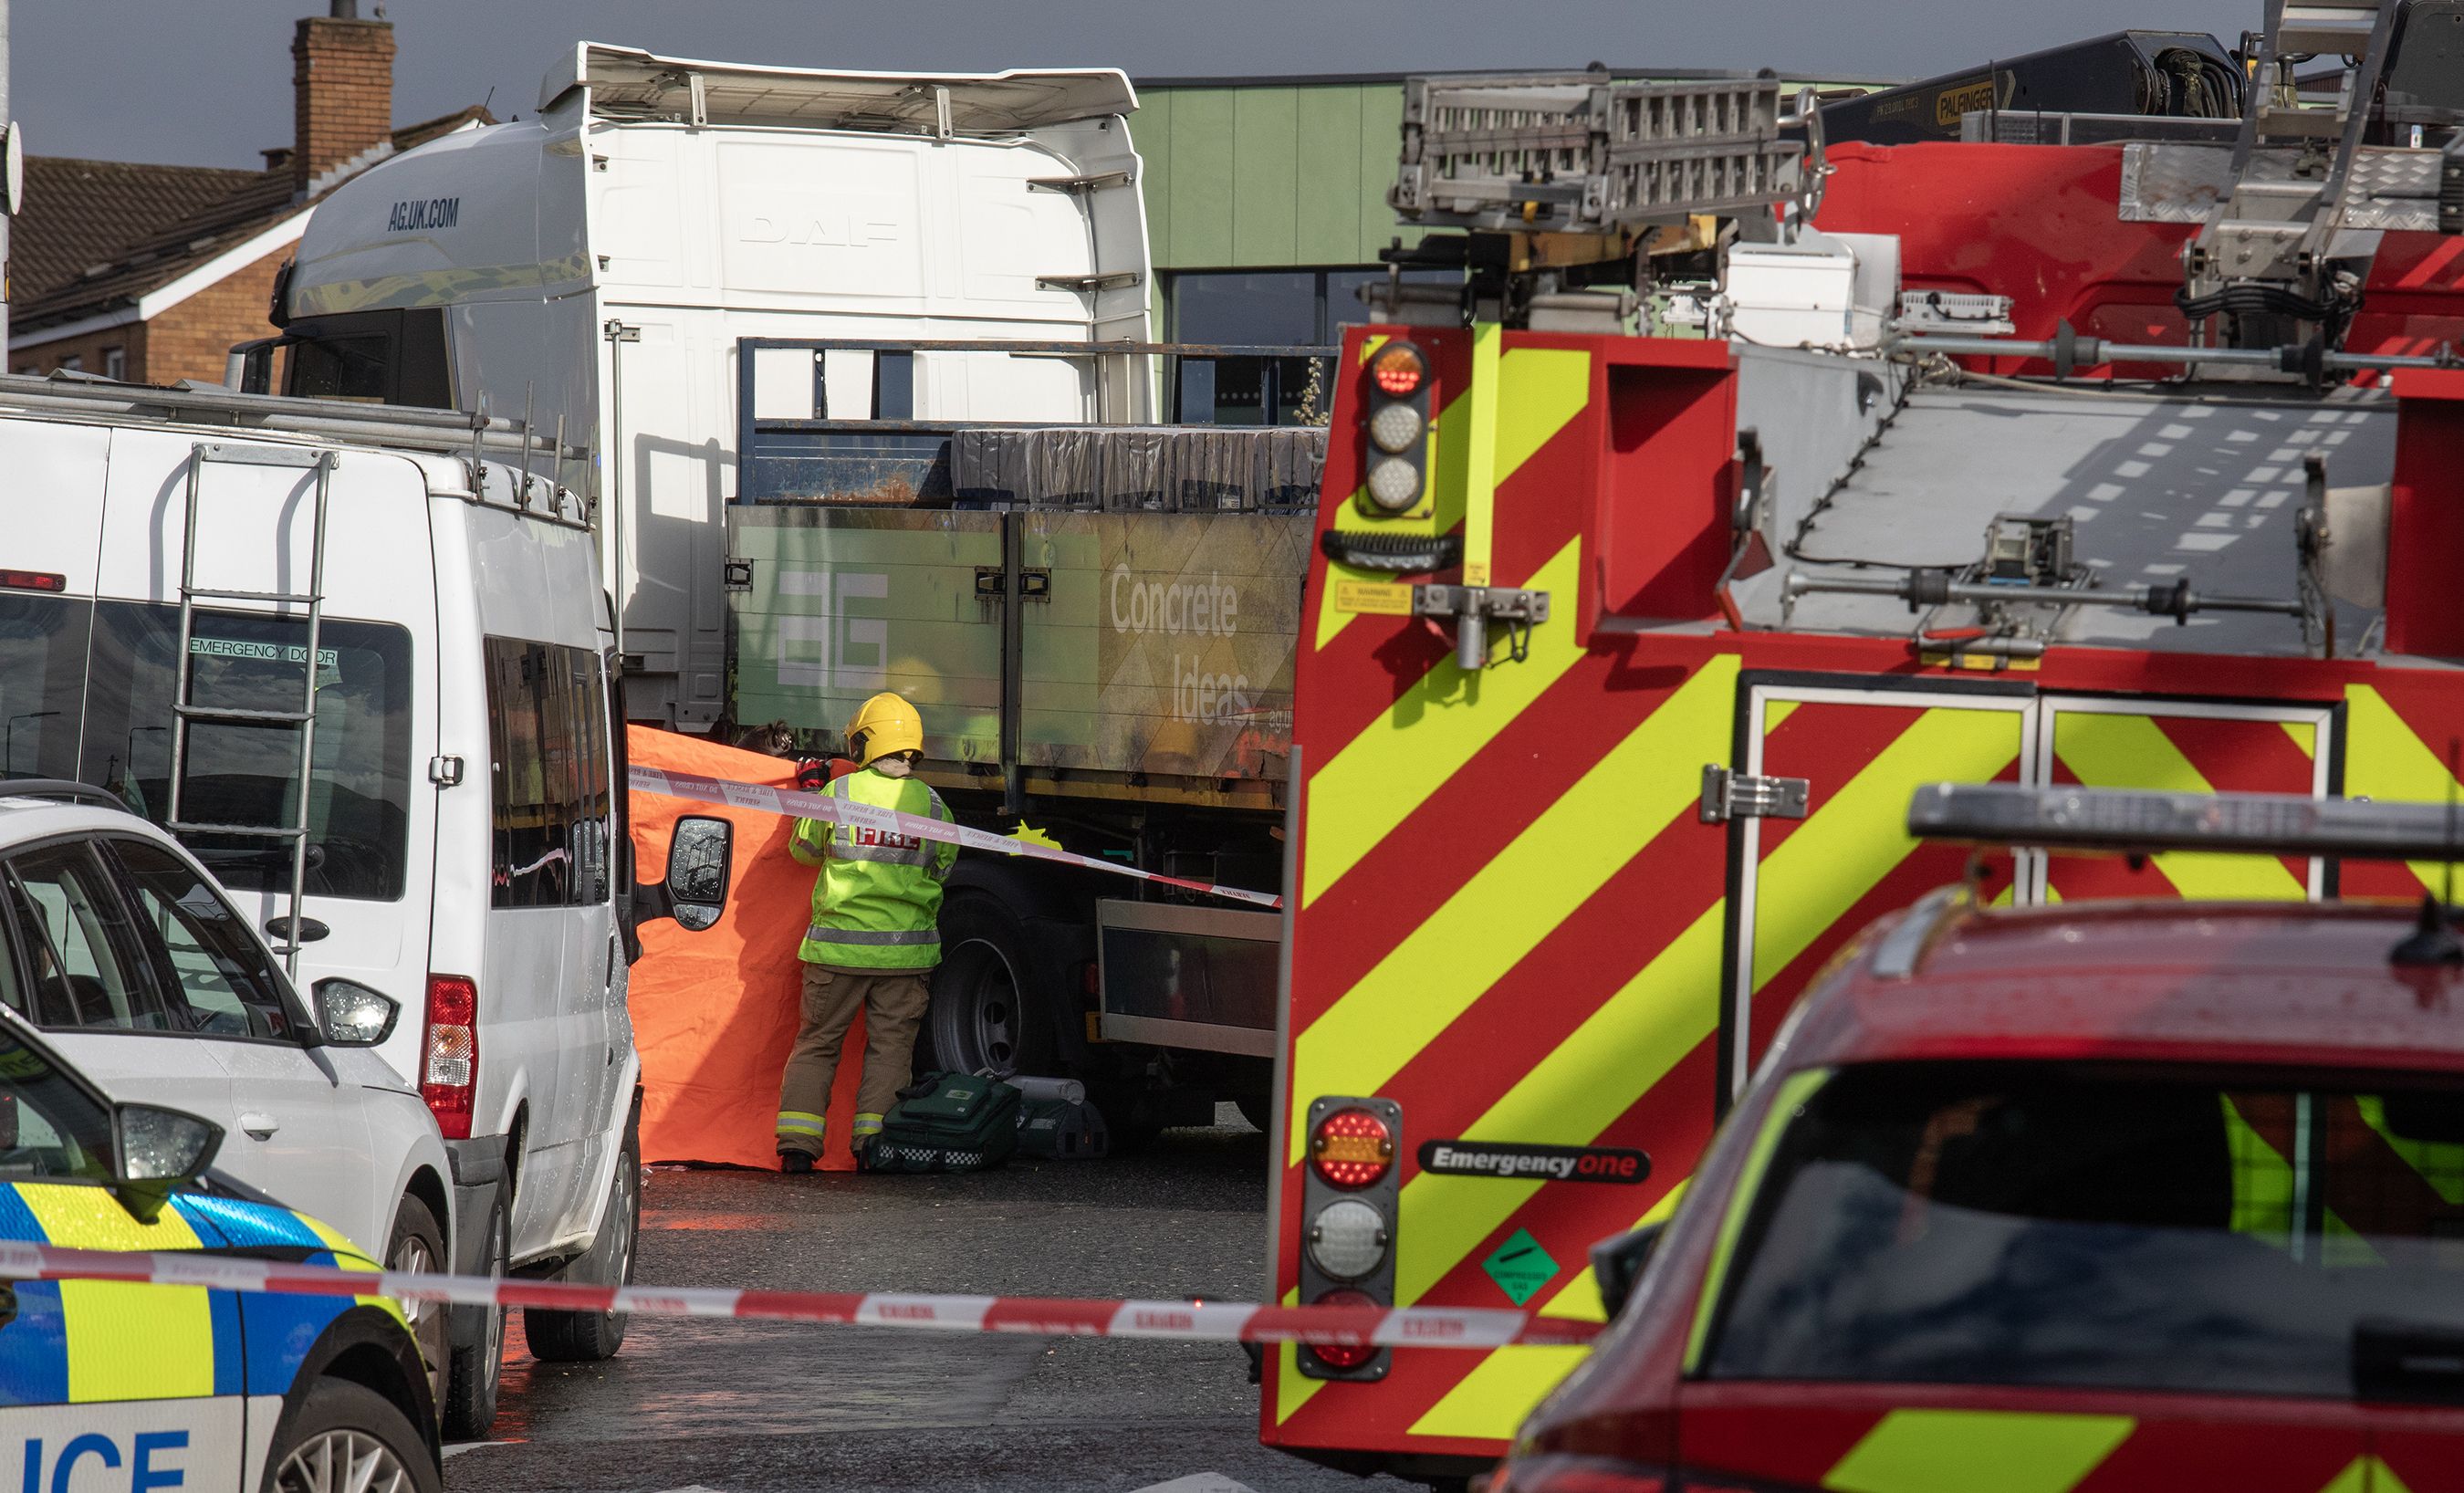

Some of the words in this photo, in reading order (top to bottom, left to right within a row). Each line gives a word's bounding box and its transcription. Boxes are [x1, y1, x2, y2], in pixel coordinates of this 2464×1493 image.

[1940, 88, 1993, 120] PALFINGER
[388, 197, 459, 232] AG.UK.COM
[737, 212, 898, 247] DAF
[1111, 562, 1237, 638] Concrete
[190, 640, 285, 659] EMERGENCY
[1269, 709, 1293, 734] ag.u
[1431, 1146, 1577, 1178] Emergency
